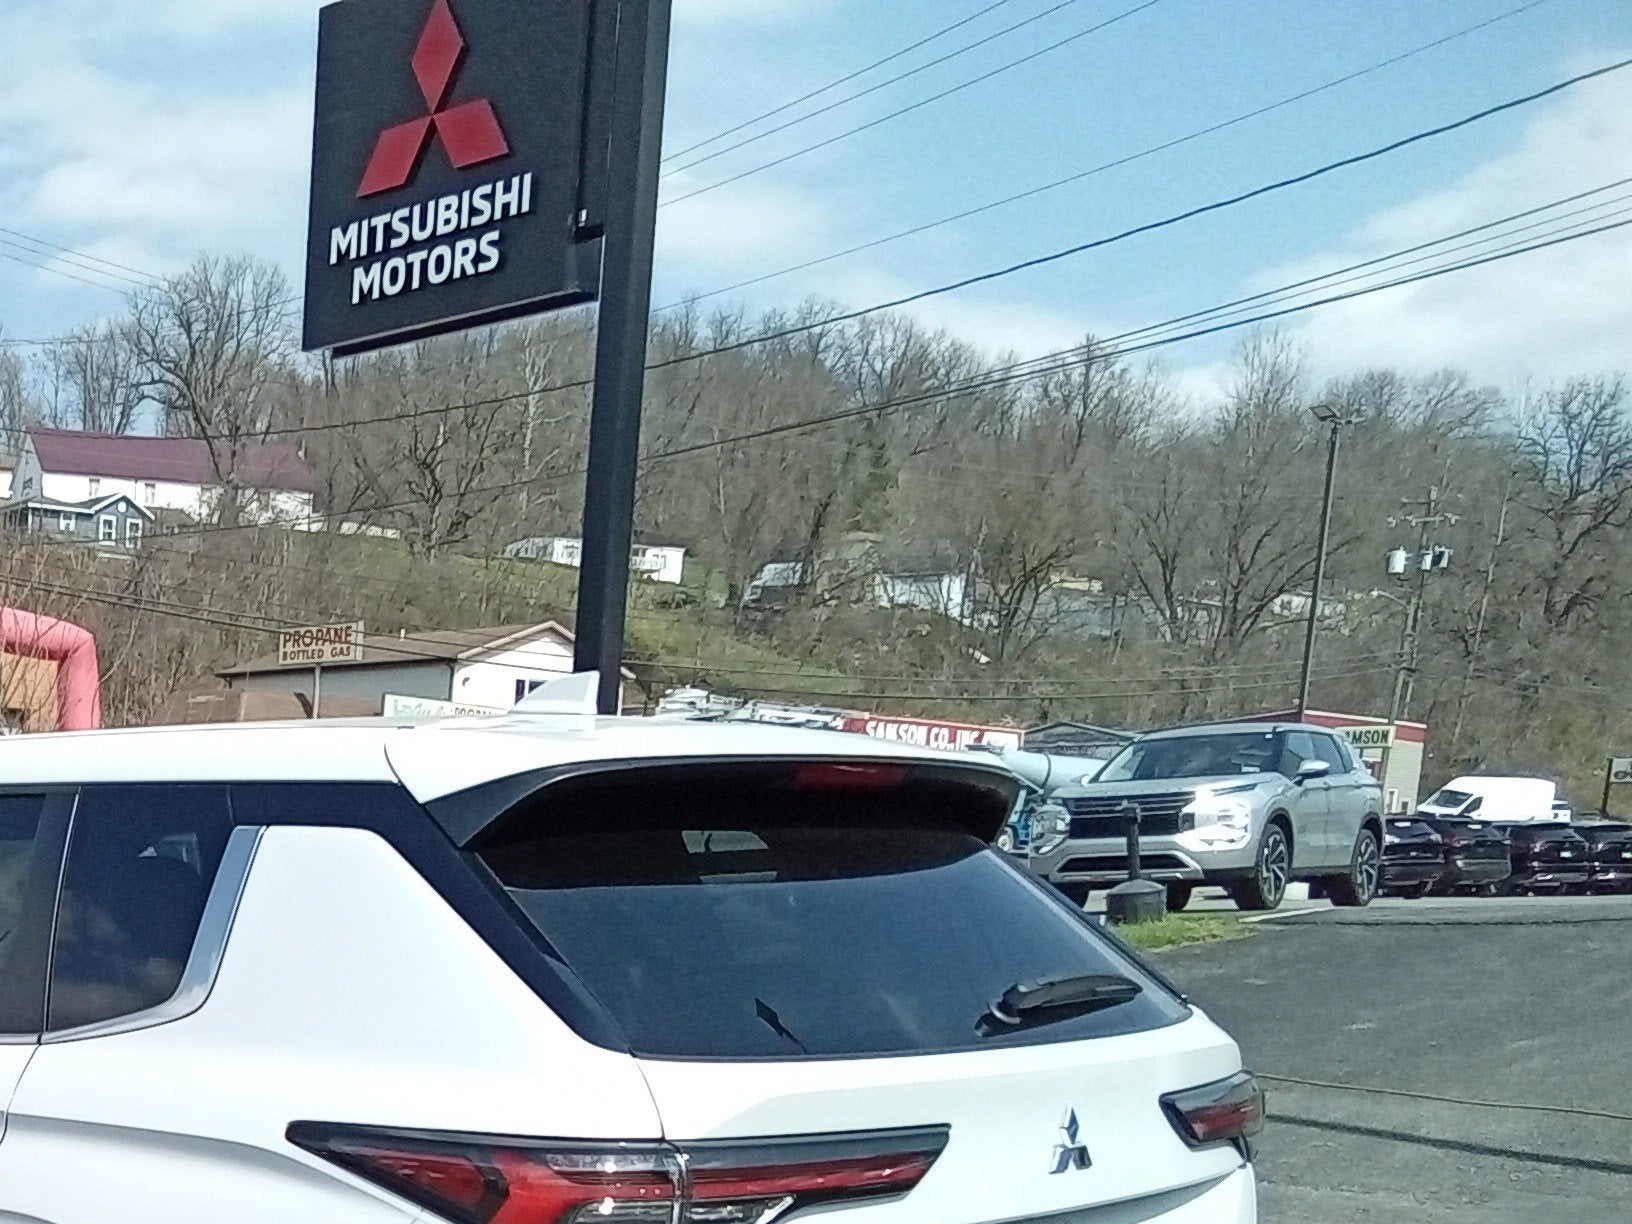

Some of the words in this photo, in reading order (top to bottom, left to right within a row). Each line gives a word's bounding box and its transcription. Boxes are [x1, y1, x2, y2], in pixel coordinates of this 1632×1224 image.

[329, 171, 533, 266] MITSUBISHI
[350, 230, 501, 305] MOTORS
[283, 625, 353, 649] PROPANE
[282, 648, 325, 662] BOTTLED
[330, 646, 352, 659] GAS
[865, 720, 928, 747] SAMSON
